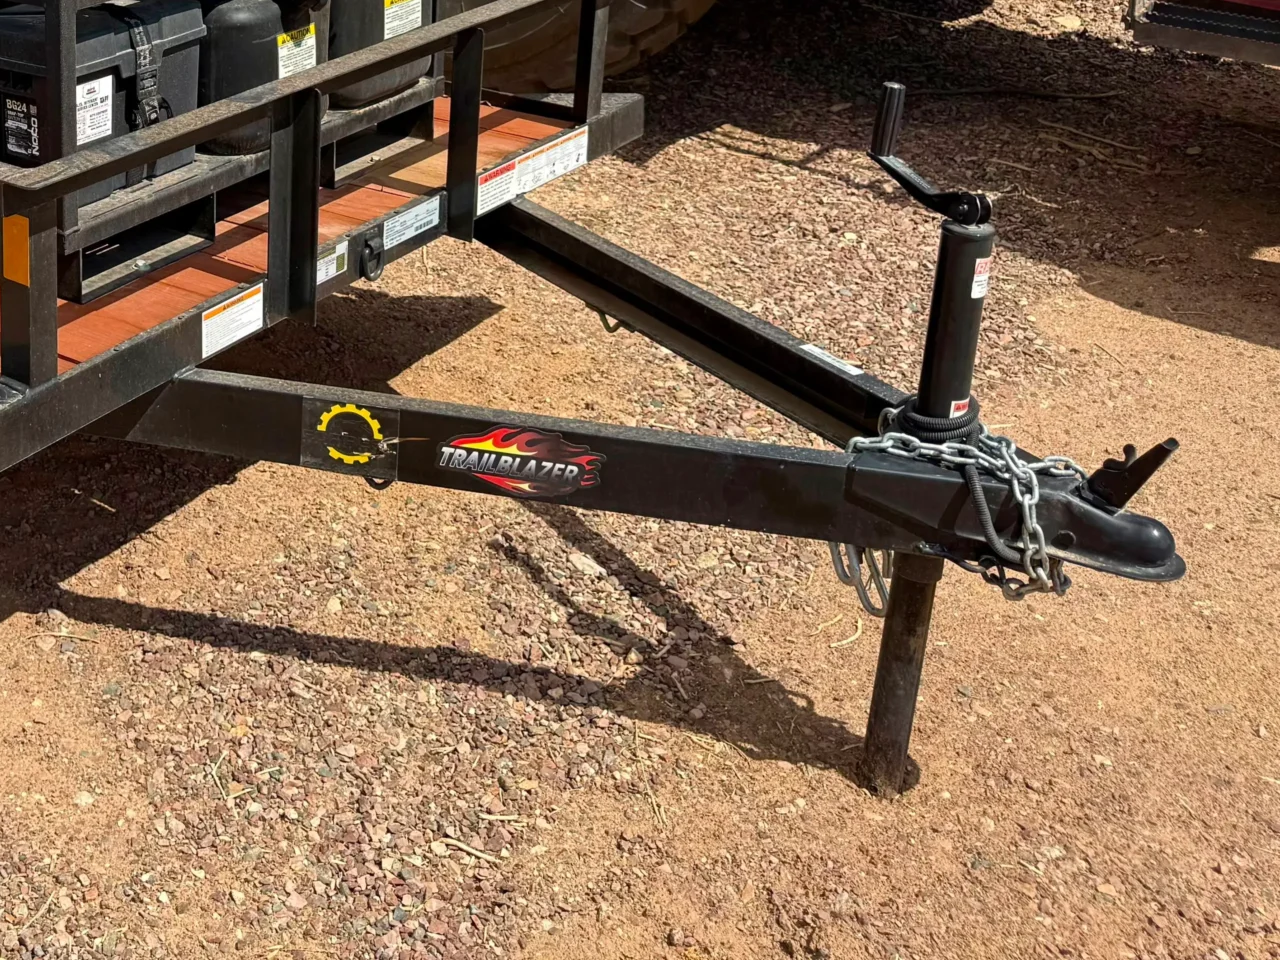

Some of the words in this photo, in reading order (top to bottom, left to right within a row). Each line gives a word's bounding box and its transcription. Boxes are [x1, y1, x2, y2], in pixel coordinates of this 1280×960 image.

[286, 27, 311, 43] CAUTION
[6, 99, 27, 113] BG24
[31, 117, 39, 156] NOCO
[439, 446, 579, 483] TRAILBLAZER
